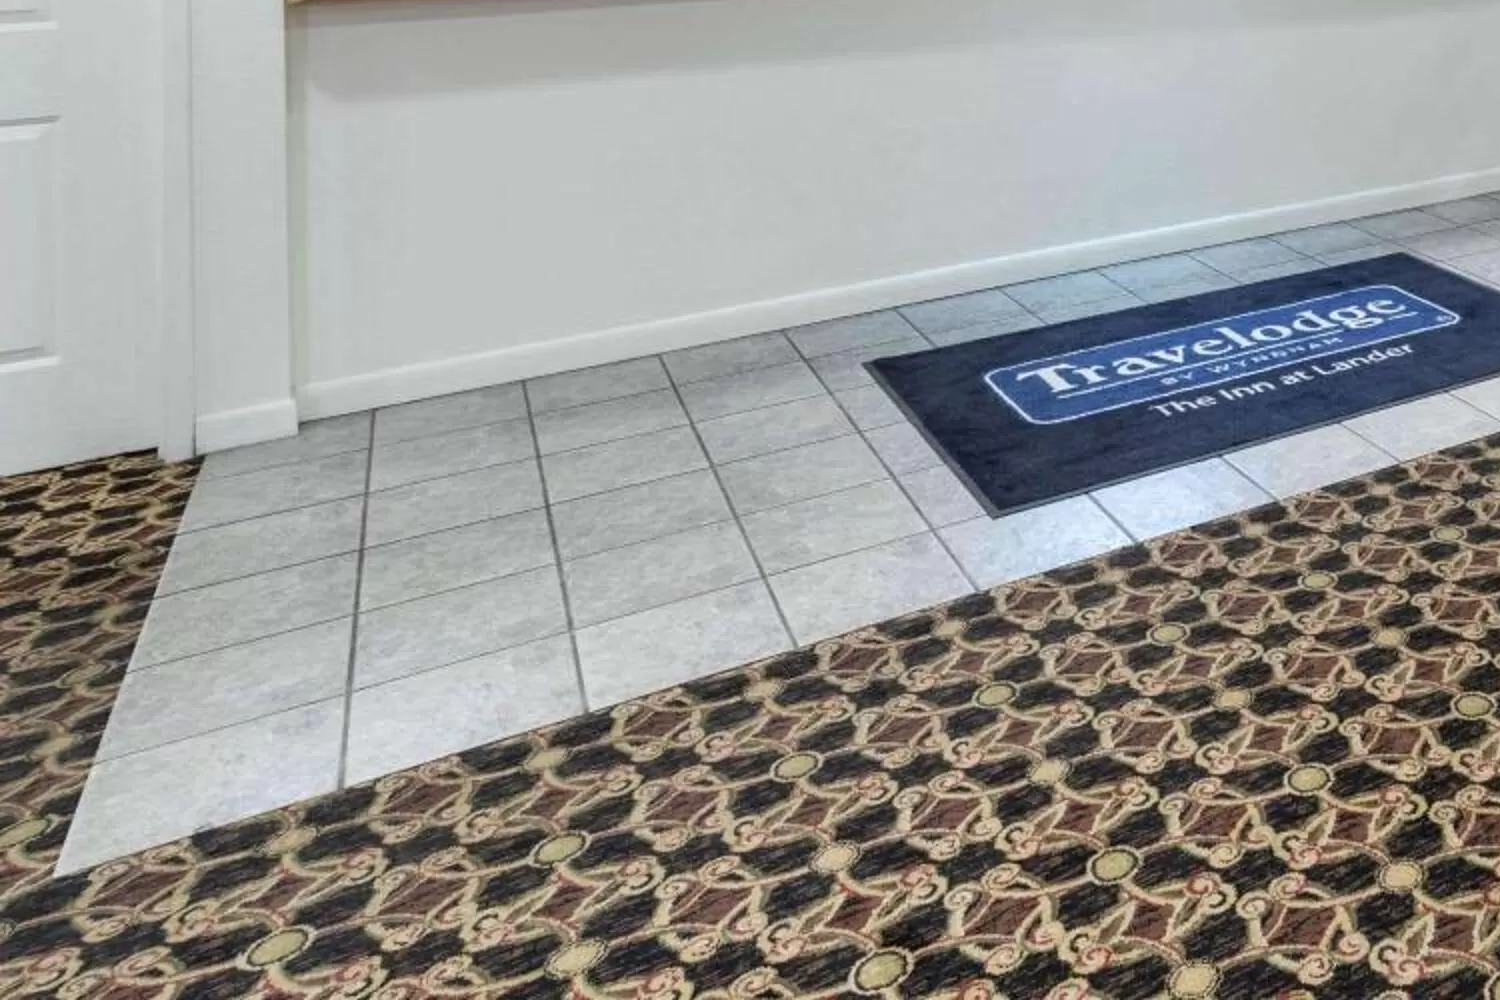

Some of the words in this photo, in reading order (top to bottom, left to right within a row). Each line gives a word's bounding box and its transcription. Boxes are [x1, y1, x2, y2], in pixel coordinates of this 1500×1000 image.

[1015, 299, 1407, 394] Travelodge
[1150, 394, 1217, 417] The
[1218, 378, 1277, 401] Inn
[1279, 368, 1315, 386] at
[1311, 342, 1415, 377] Lander
[1159, 371, 1194, 387] BY
